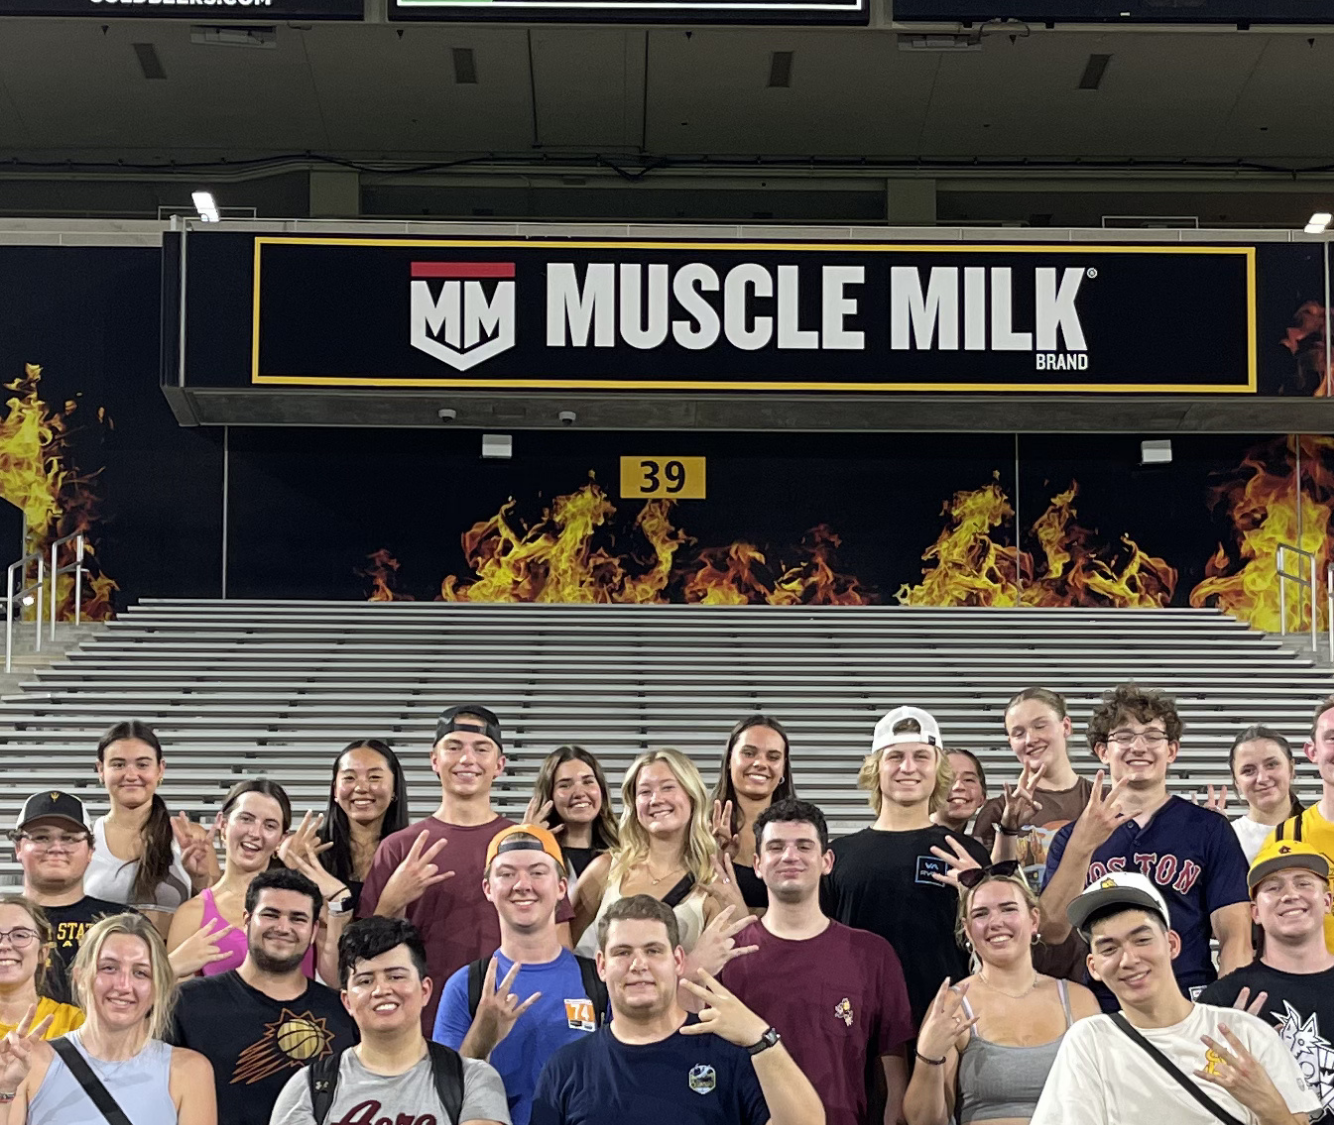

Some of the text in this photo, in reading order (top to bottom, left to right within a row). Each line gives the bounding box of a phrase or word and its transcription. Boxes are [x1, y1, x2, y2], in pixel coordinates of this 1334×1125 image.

[546, 262, 865, 350] MUSCLE
[1036, 353, 1088, 370] BRAND
[639, 460, 686, 493] 39
[1086, 852, 1201, 895] OSTON
[571, 1004, 590, 1020] 74
